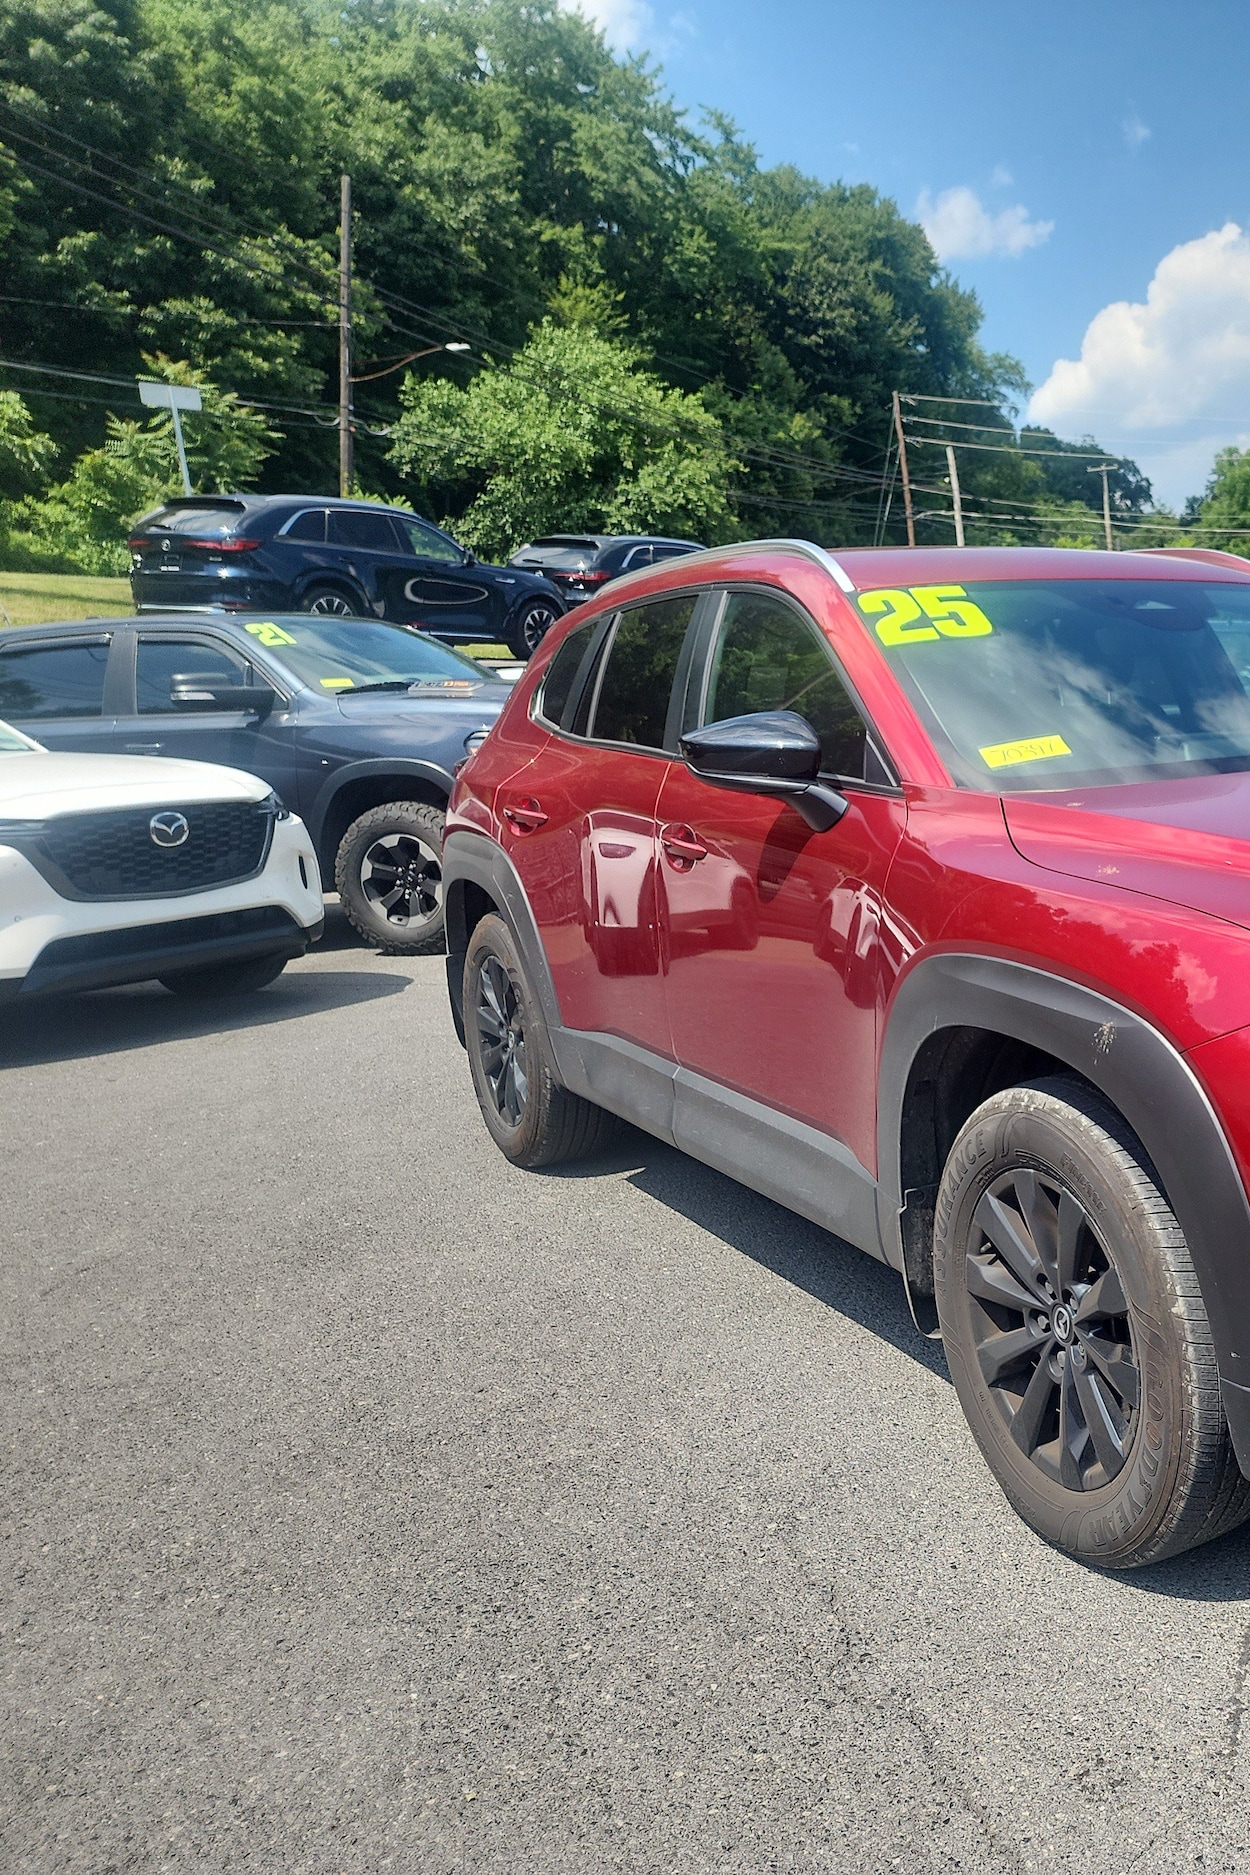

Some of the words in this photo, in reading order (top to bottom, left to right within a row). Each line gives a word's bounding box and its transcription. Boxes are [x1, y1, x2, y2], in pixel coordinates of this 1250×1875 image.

[244, 622, 298, 647] 21
[857, 585, 993, 646] 25
[935, 1129, 987, 1304] ASSURANCE
[1089, 1361, 1164, 1547] GOODYEAR
